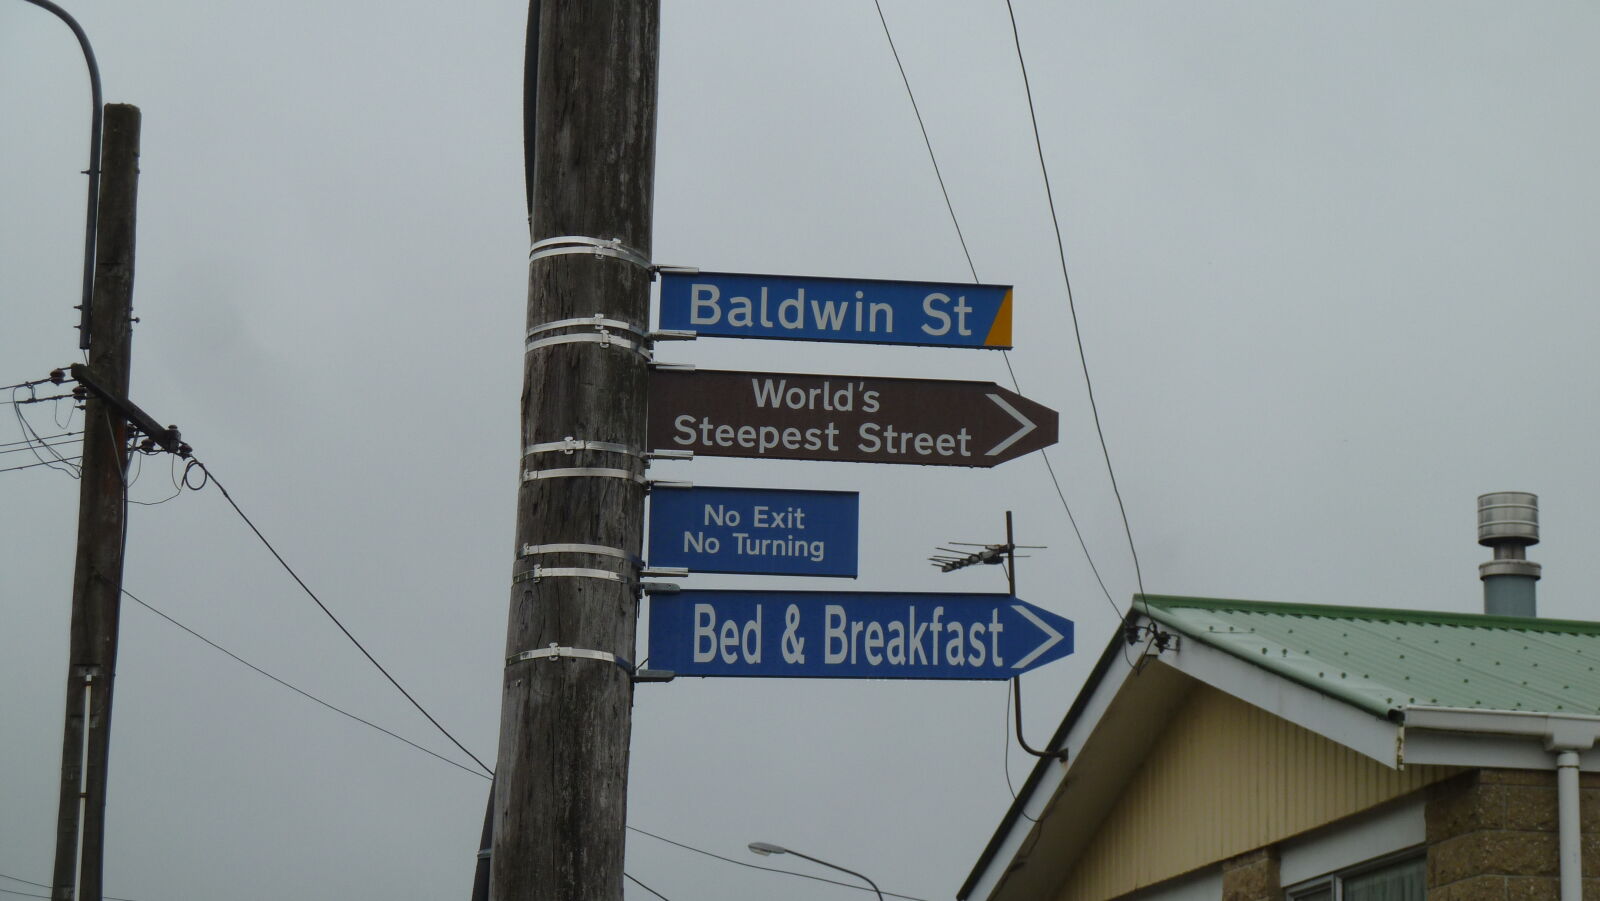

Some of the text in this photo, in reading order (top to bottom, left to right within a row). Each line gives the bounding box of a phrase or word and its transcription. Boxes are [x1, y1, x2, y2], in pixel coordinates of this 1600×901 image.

[690, 284, 973, 336] Baldwin St
[751, 378, 880, 413] World's
[673, 414, 972, 457] Steepest Street
[704, 504, 805, 529] No Exit
[684, 531, 824, 562] No Turning
[693, 603, 1003, 667] Bed & Breakfast
